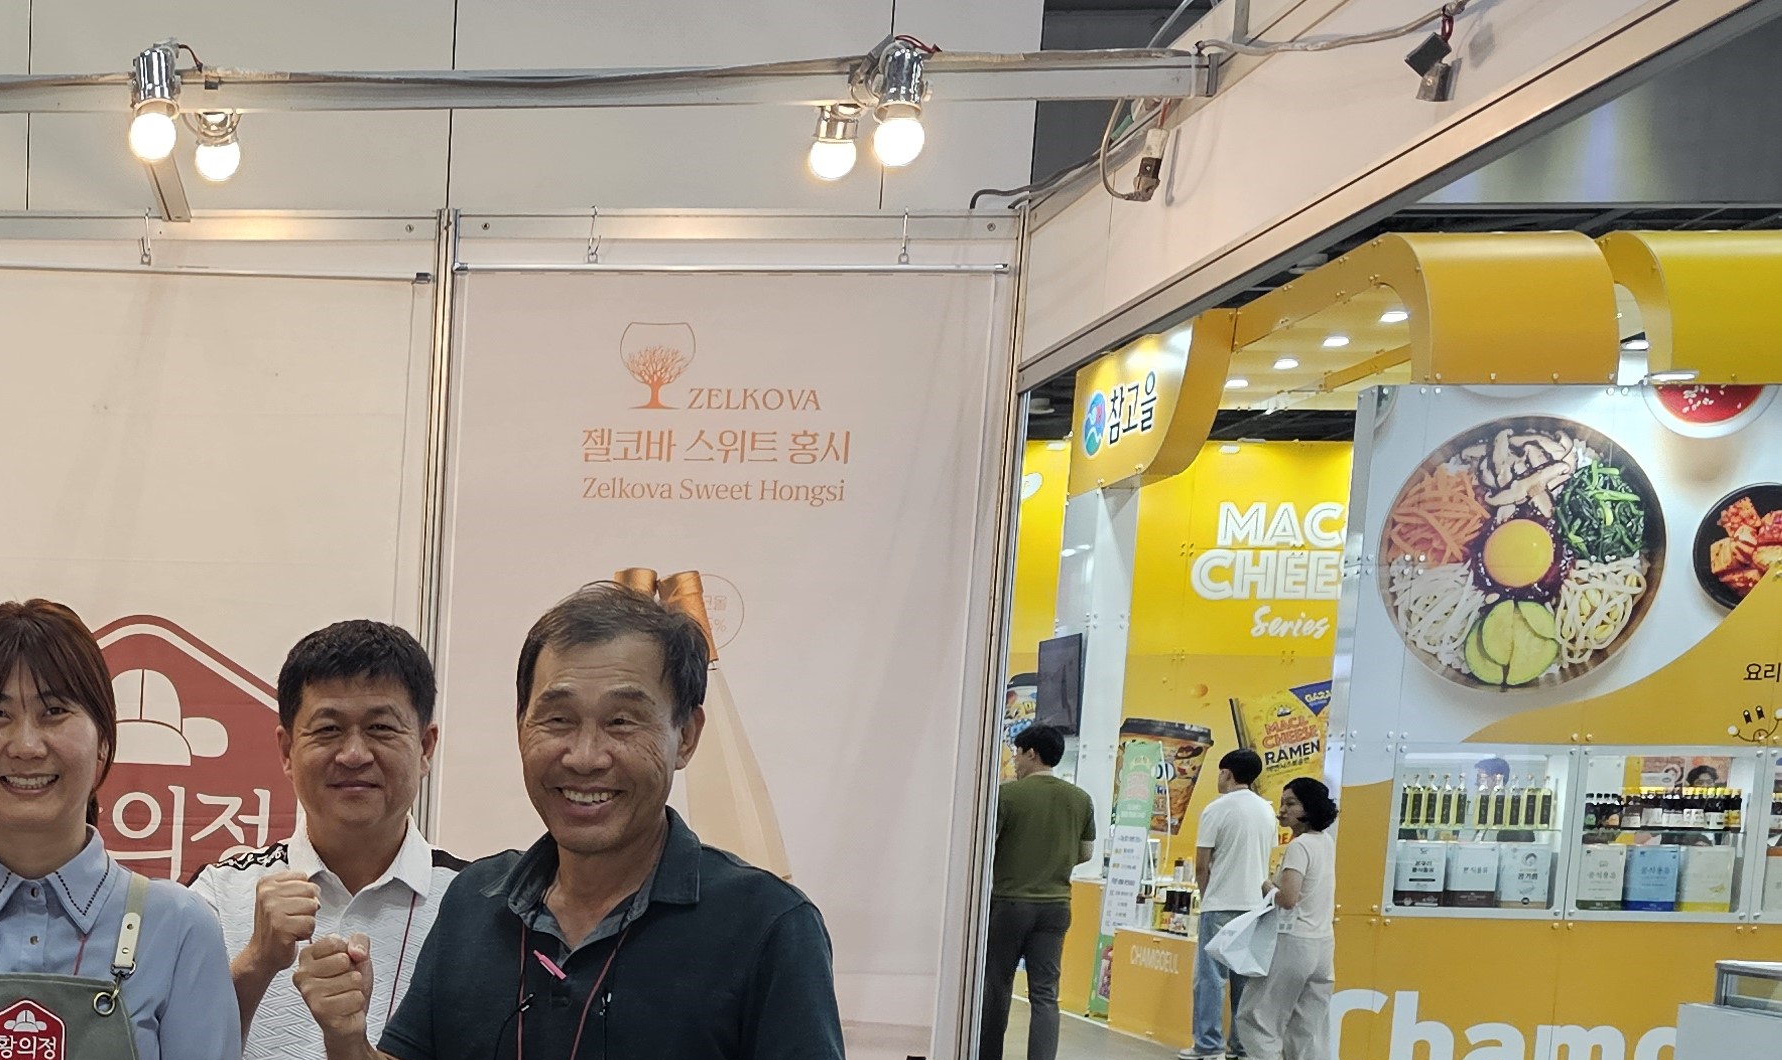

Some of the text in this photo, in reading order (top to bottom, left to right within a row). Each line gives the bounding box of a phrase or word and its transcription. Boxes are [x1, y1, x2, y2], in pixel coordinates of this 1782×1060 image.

[687, 388, 822, 410] ZELKOVA
[1108, 371, 1156, 444] 참고을
[582, 428, 850, 464] 젤코바 스위트 홍시
[582, 477, 845, 507] Zelkova Sweet Hongsi
[1191, 549, 1343, 600] CHEE
[1251, 606, 1329, 639] Series
[1743, 662, 1781, 682] 요리
[1265, 740, 1320, 765] RAMEN
[100, 786, 271, 880] 의정
